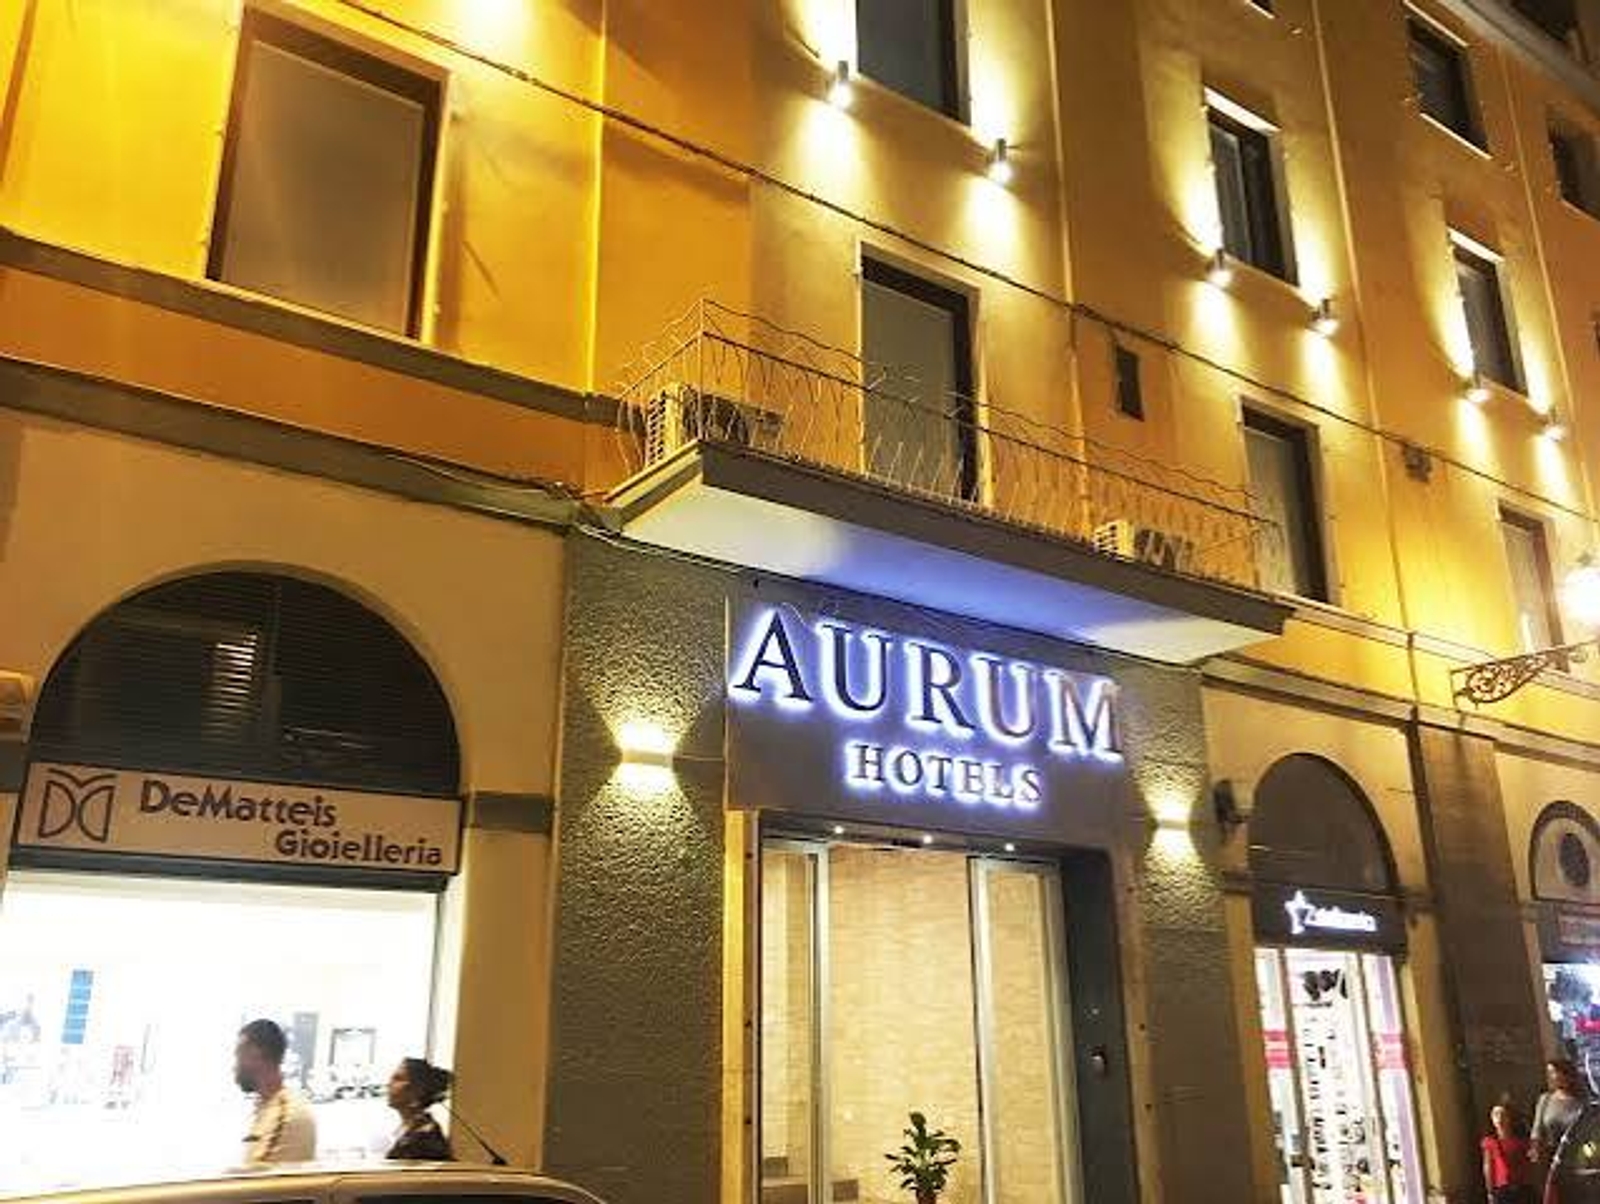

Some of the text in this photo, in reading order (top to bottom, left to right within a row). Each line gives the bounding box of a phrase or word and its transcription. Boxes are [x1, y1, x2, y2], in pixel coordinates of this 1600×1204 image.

[732, 608, 1125, 756] AURUM
[850, 744, 1041, 801] HOTELS
[139, 779, 336, 827] DeMatteis
[275, 831, 442, 866] Gioielleria
